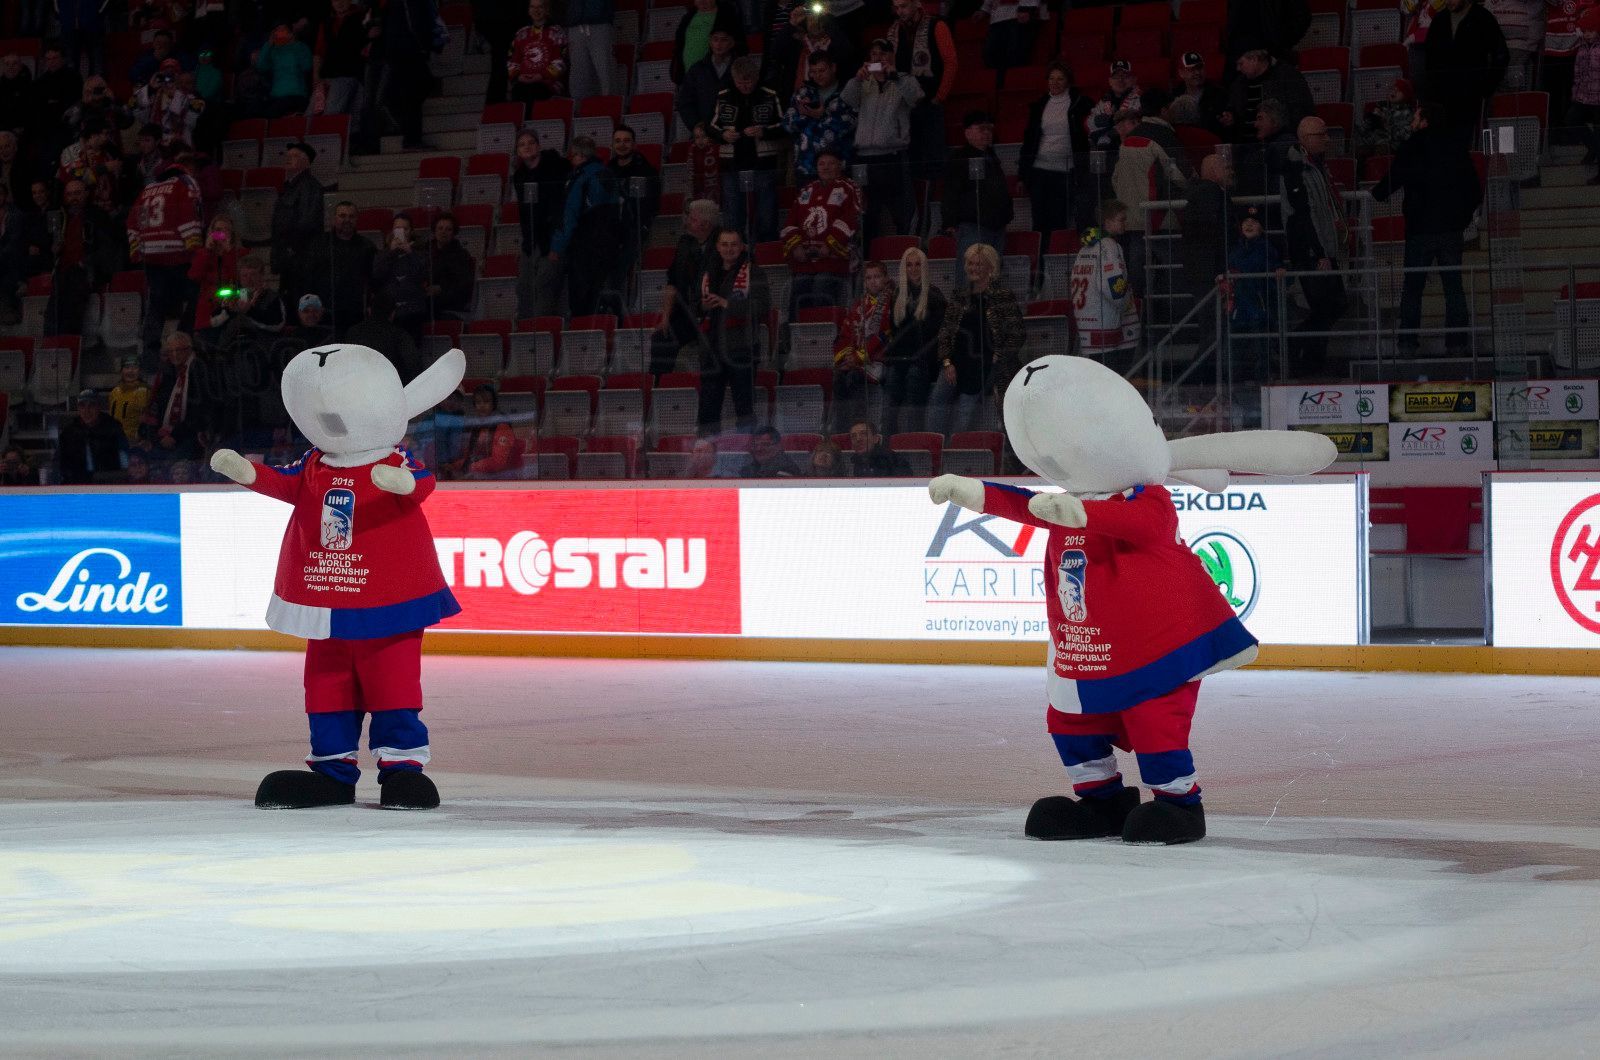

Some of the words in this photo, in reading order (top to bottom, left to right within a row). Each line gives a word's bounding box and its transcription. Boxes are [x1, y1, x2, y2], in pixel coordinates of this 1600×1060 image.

[1408, 396, 1429, 406] FAIR
[1431, 396, 1456, 406] PLAY
[1402, 427, 1446, 441] KR
[1536, 434, 1562, 443] PLAY
[332, 477, 354, 486] 2015
[328, 495, 350, 505] IIHF
[1171, 488, 1267, 511] ŠKODA
[1064, 535, 1085, 546] 2015
[309, 551, 323, 559] ICE
[325, 552, 363, 561] HOCKEY
[319, 560, 351, 568] WORLD
[304, 566, 369, 576] CHAMPIONSHIP
[16, 548, 168, 613] Linde
[328, 576, 367, 585] REPUBLIC
[307, 584, 330, 592] Prague
[334, 585, 360, 593] Ostrava
[925, 616, 1019, 636] autorizovaný
[1065, 633, 1091, 643] WORLD
[1071, 653, 1112, 662] REPUBLIC
[1077, 663, 1107, 671] Ostrava
